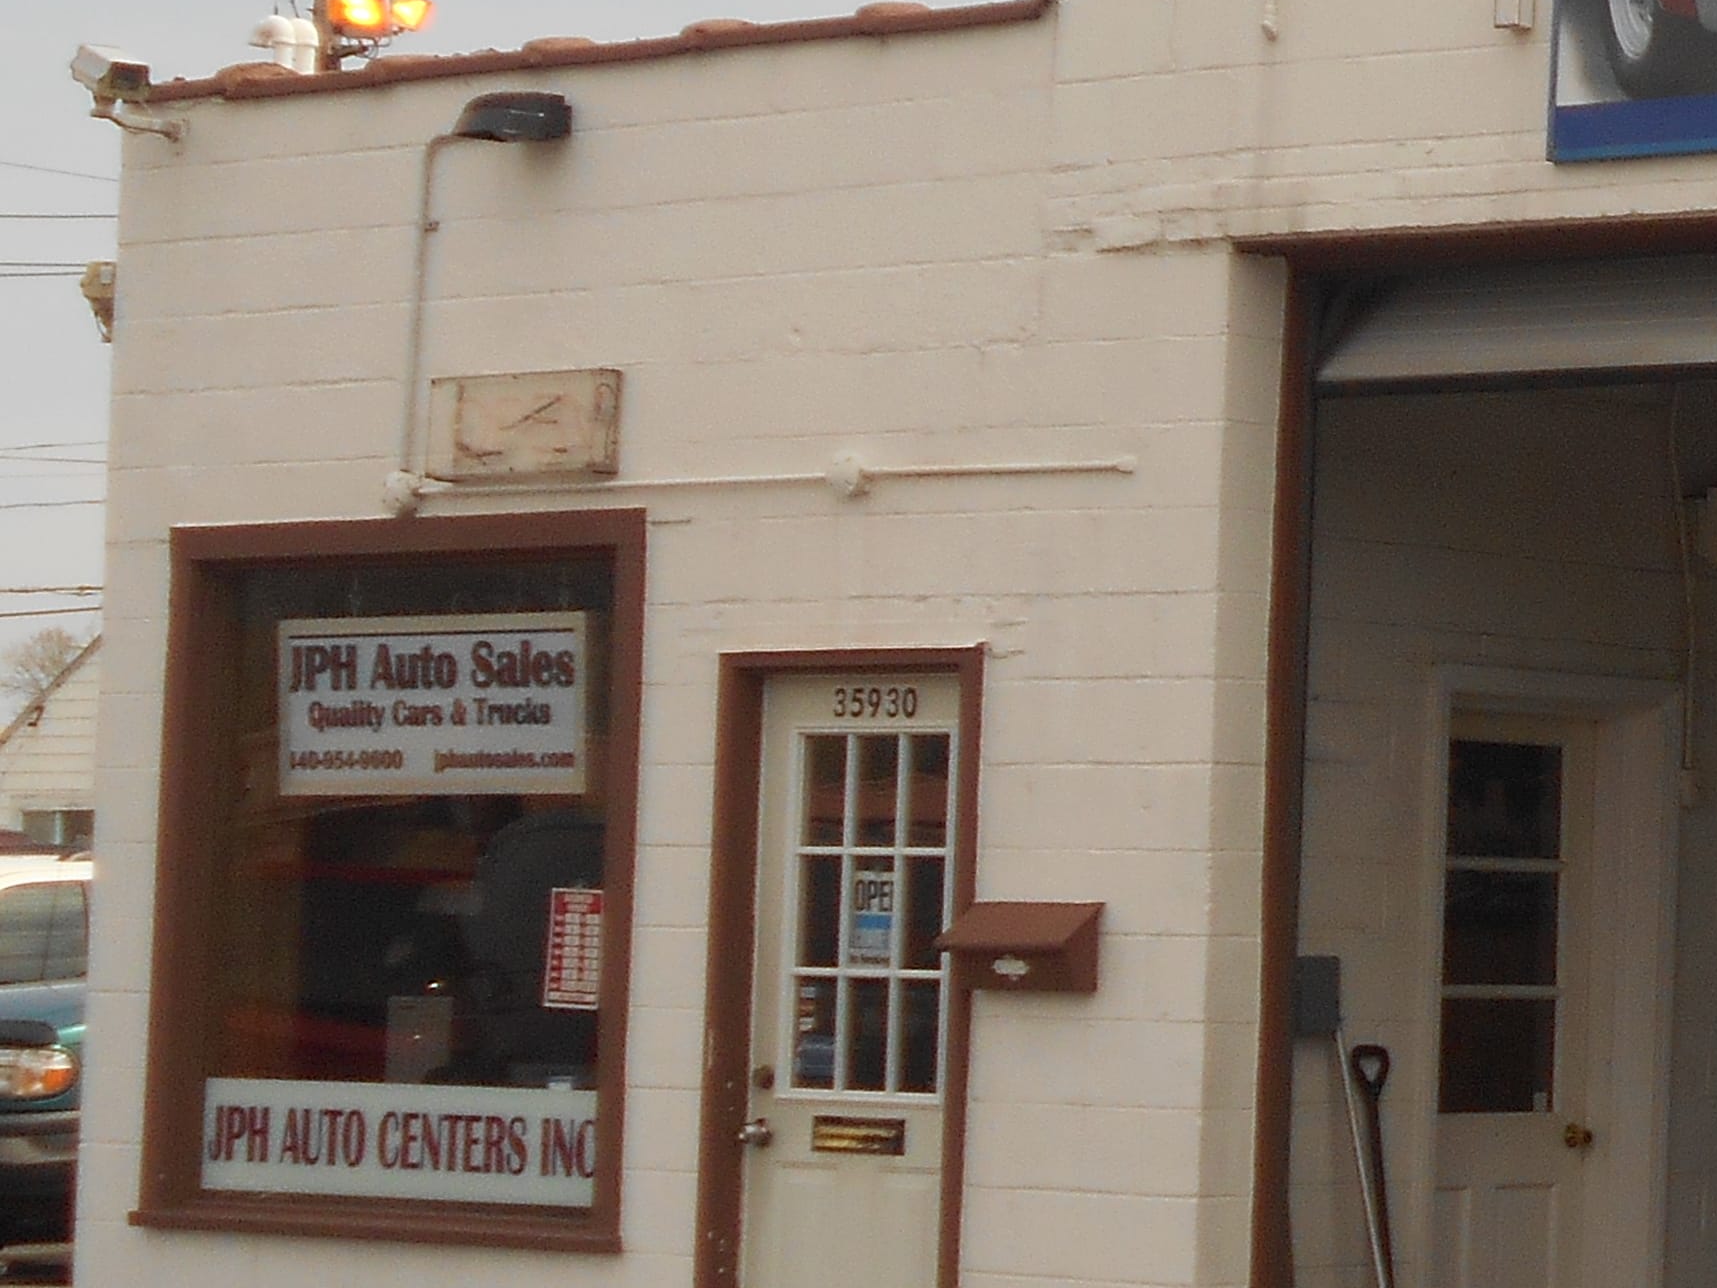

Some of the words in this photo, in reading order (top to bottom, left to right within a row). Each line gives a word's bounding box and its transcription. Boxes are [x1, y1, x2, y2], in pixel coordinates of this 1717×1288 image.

[289, 643, 358, 692] JPH
[370, 643, 458, 691] Auto
[470, 639, 576, 688] Sales
[392, 699, 443, 727] Cars
[833, 687, 918, 718] 35930
[855, 879, 894, 912] OPE
[209, 1105, 271, 1162] JPH
[280, 1108, 367, 1167] AUTO
[376, 1110, 528, 1175] CENTERS
[540, 1117, 597, 1178] INC
